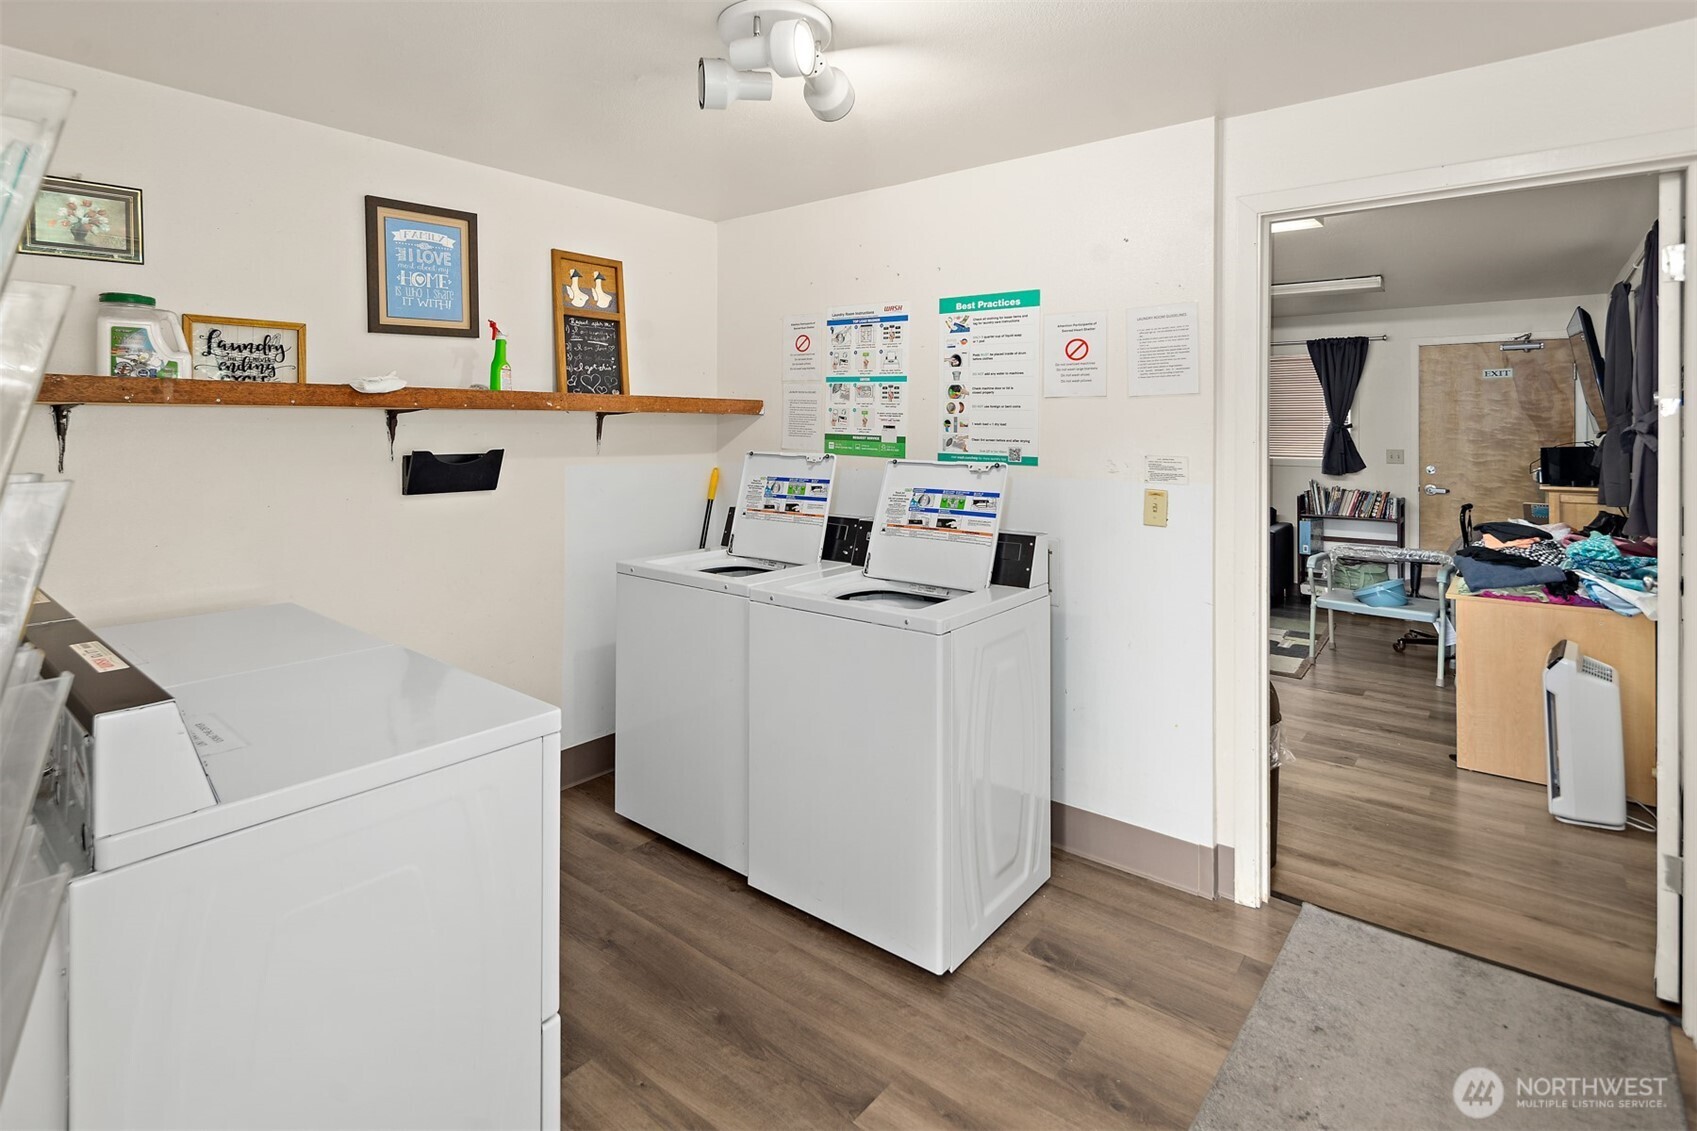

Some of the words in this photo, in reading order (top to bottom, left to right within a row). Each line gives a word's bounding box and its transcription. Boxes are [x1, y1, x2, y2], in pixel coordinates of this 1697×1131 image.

[404, 231, 445, 243] FAMILY
[416, 249, 452, 267] LOVE
[400, 270, 449, 290] HOME
[402, 296, 414, 306] IT
[956, 302, 976, 310] Best
[978, 298, 1021, 308] Practices
[200, 328, 290, 363] Laundry
[218, 356, 276, 378] ending
